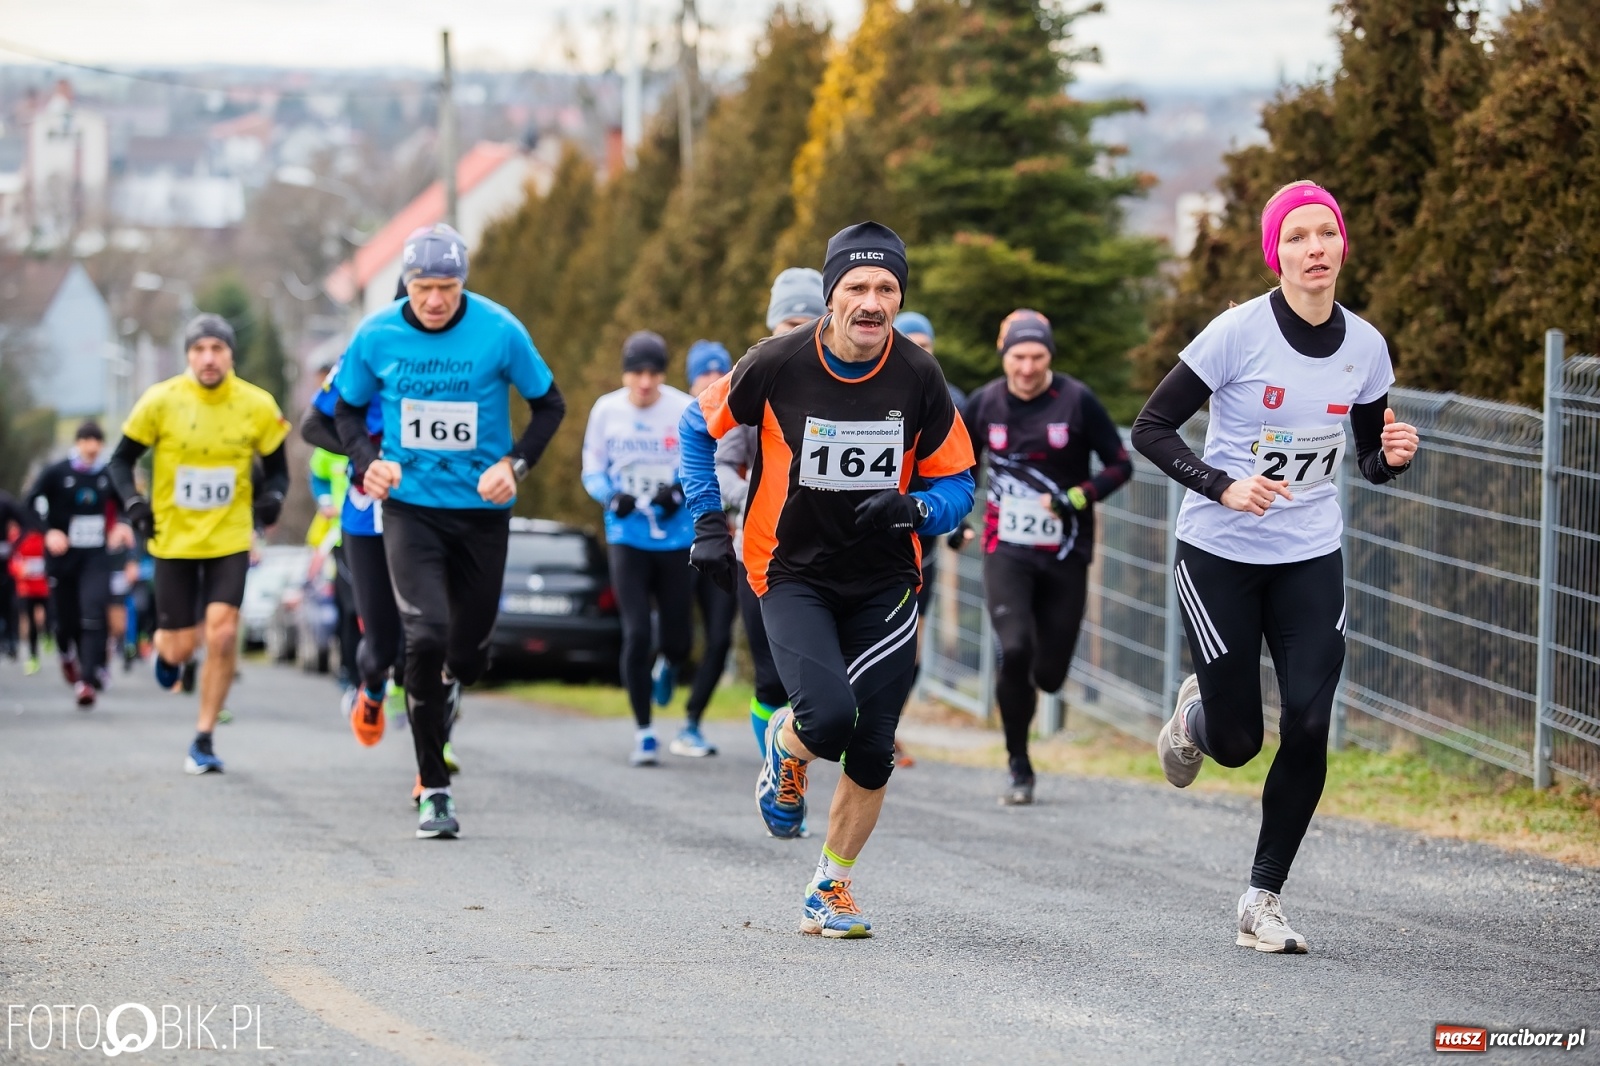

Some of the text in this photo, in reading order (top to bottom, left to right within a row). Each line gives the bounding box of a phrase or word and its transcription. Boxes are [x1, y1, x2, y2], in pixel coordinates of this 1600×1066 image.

[850, 251, 884, 260] SELECT
[396, 358, 473, 374] Triathlon
[396, 378, 470, 396] Gogolin
[408, 419, 471, 442] 166
[810, 445, 897, 478] 164
[1172, 458, 1209, 480] KIPSTA
[1261, 447, 1338, 482] 271
[184, 482, 230, 502] 130
[1005, 512, 1056, 536] 326
